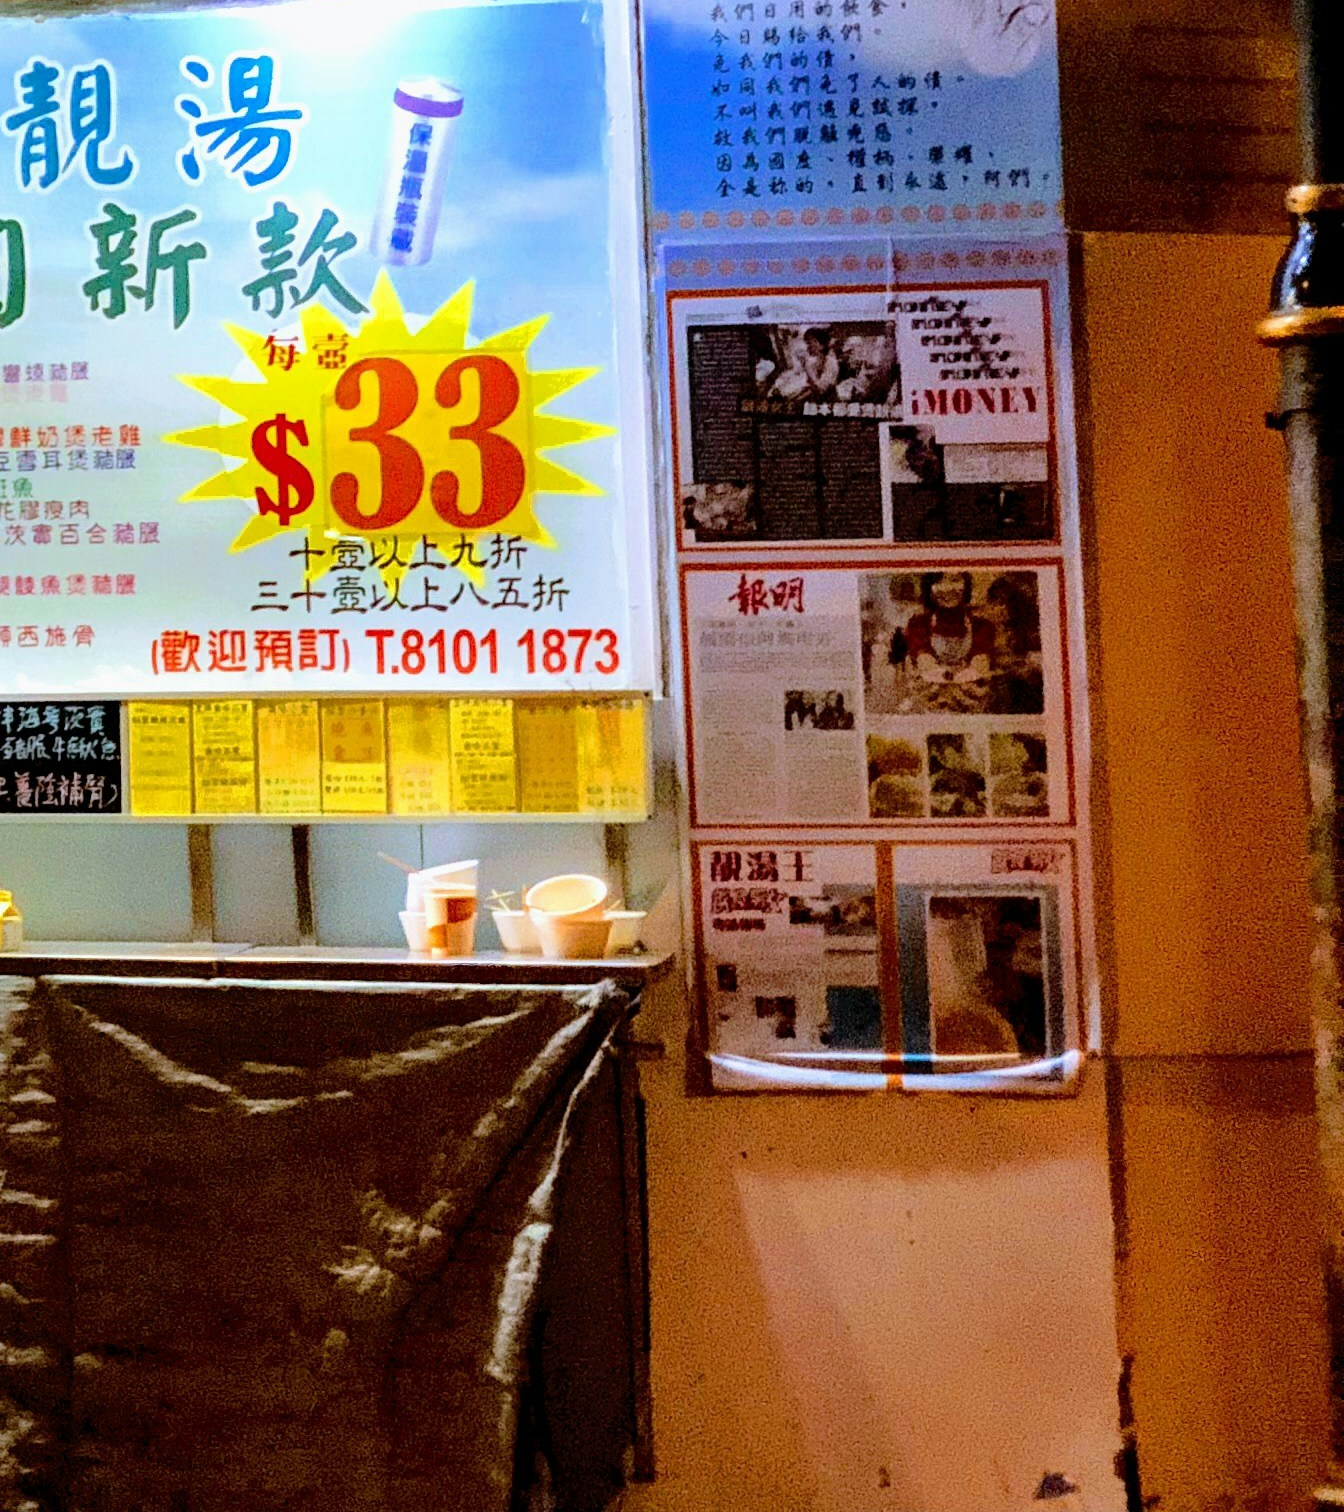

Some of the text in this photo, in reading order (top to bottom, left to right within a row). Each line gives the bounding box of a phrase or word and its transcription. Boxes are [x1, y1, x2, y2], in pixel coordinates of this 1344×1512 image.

[911, 386, 1040, 416] iMONEY
[251, 354, 526, 530] $33
[365, 629, 498, 676] T.8101
[516, 628, 620, 675] 1873
